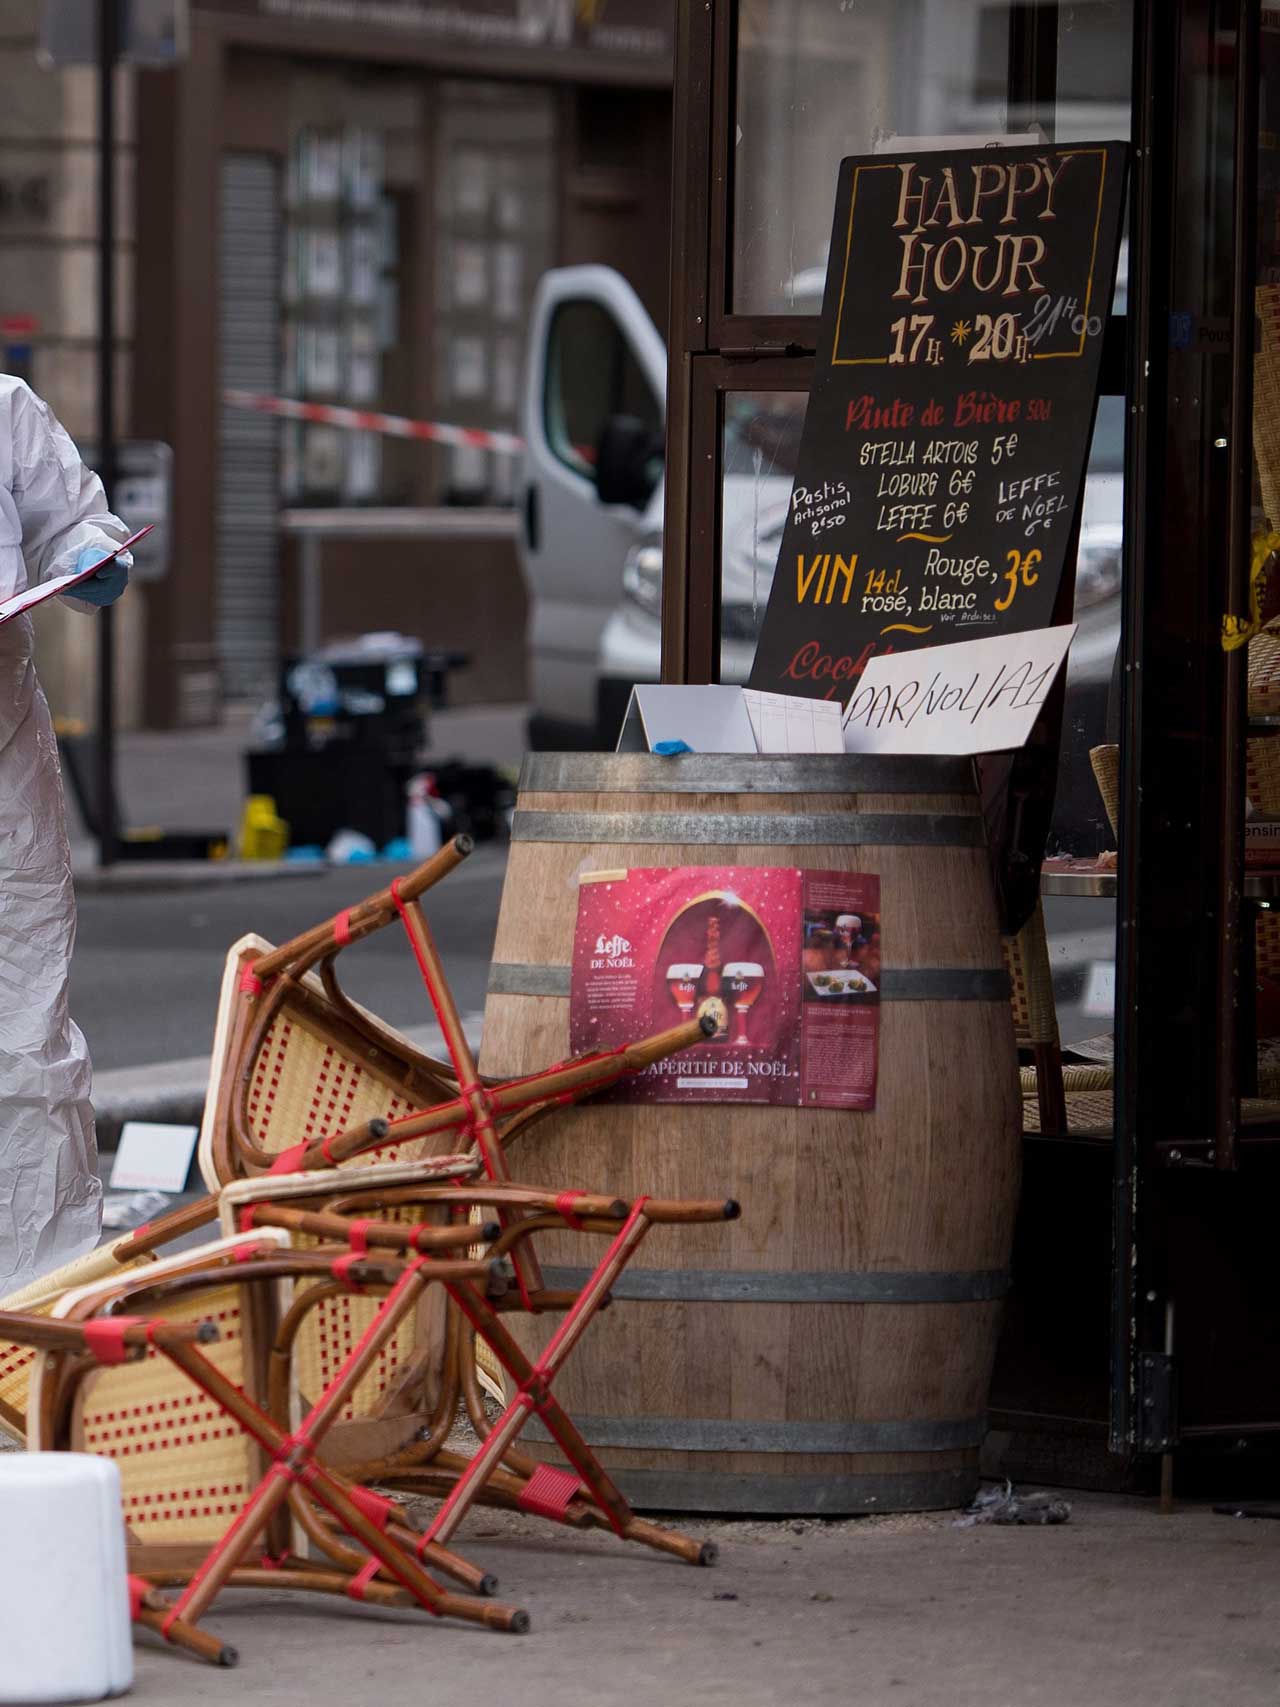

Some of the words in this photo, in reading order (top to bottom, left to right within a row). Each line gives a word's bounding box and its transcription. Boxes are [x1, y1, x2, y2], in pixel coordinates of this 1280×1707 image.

[892, 156, 1073, 233] HAPPY
[892, 234, 1047, 304] HOUR
[845, 396, 914, 432] Pinte
[921, 400, 946, 427] de
[953, 391, 1021, 427] Bière
[860, 440, 916, 466] STELLA
[922, 440, 980, 464] ARTOIS
[991, 433, 1019, 465] 5€
[792, 481, 847, 510] Pastis
[877, 472, 940, 497] LOBURG
[949, 469, 976, 496] 6€
[998, 471, 1061, 504] LEFFE
[877, 504, 937, 531] LEFFE
[943, 502, 970, 528] 6€
[995, 508, 1017, 522] DE
[797, 553, 858, 605] VIN
[924, 548, 999, 585] Rouge,
[994, 549, 1042, 611] 3€
[861, 586, 913, 616] rosé,
[918, 585, 977, 611] blanc
[595, 933, 632, 958] Leffe
[590, 960, 605, 969] DE
[721, 1061, 745, 1077] DE
